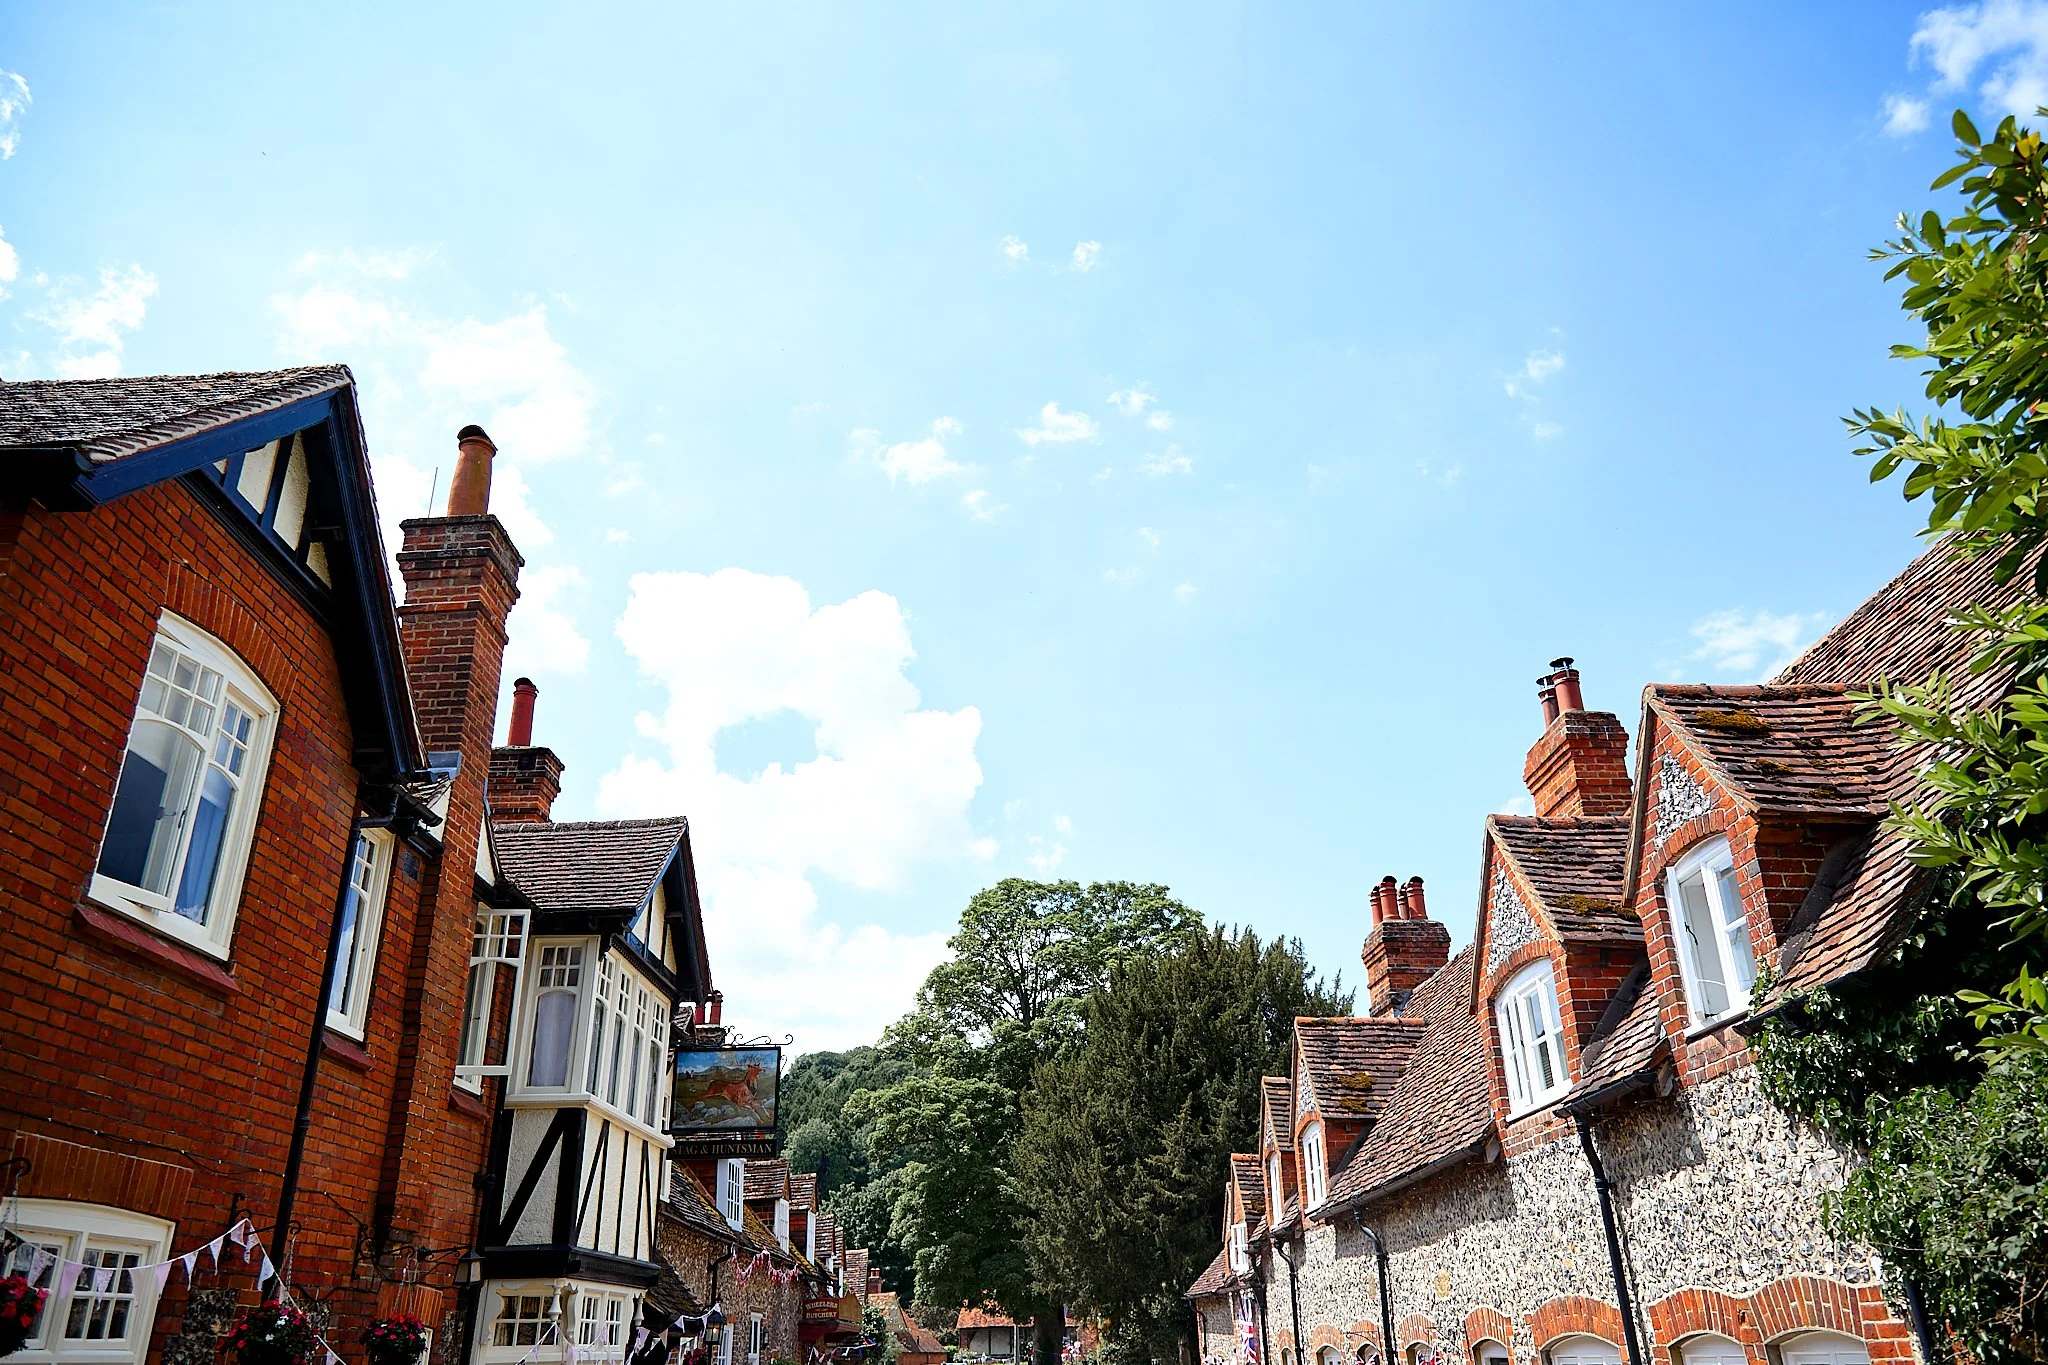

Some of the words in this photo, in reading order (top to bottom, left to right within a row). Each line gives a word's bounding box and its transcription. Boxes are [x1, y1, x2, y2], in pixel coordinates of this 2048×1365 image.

[672, 1145, 698, 1155] STAG
[700, 1145, 709, 1154] &
[712, 1143, 772, 1154] HUNTSMAN
[805, 1301, 838, 1310] WHEELERS
